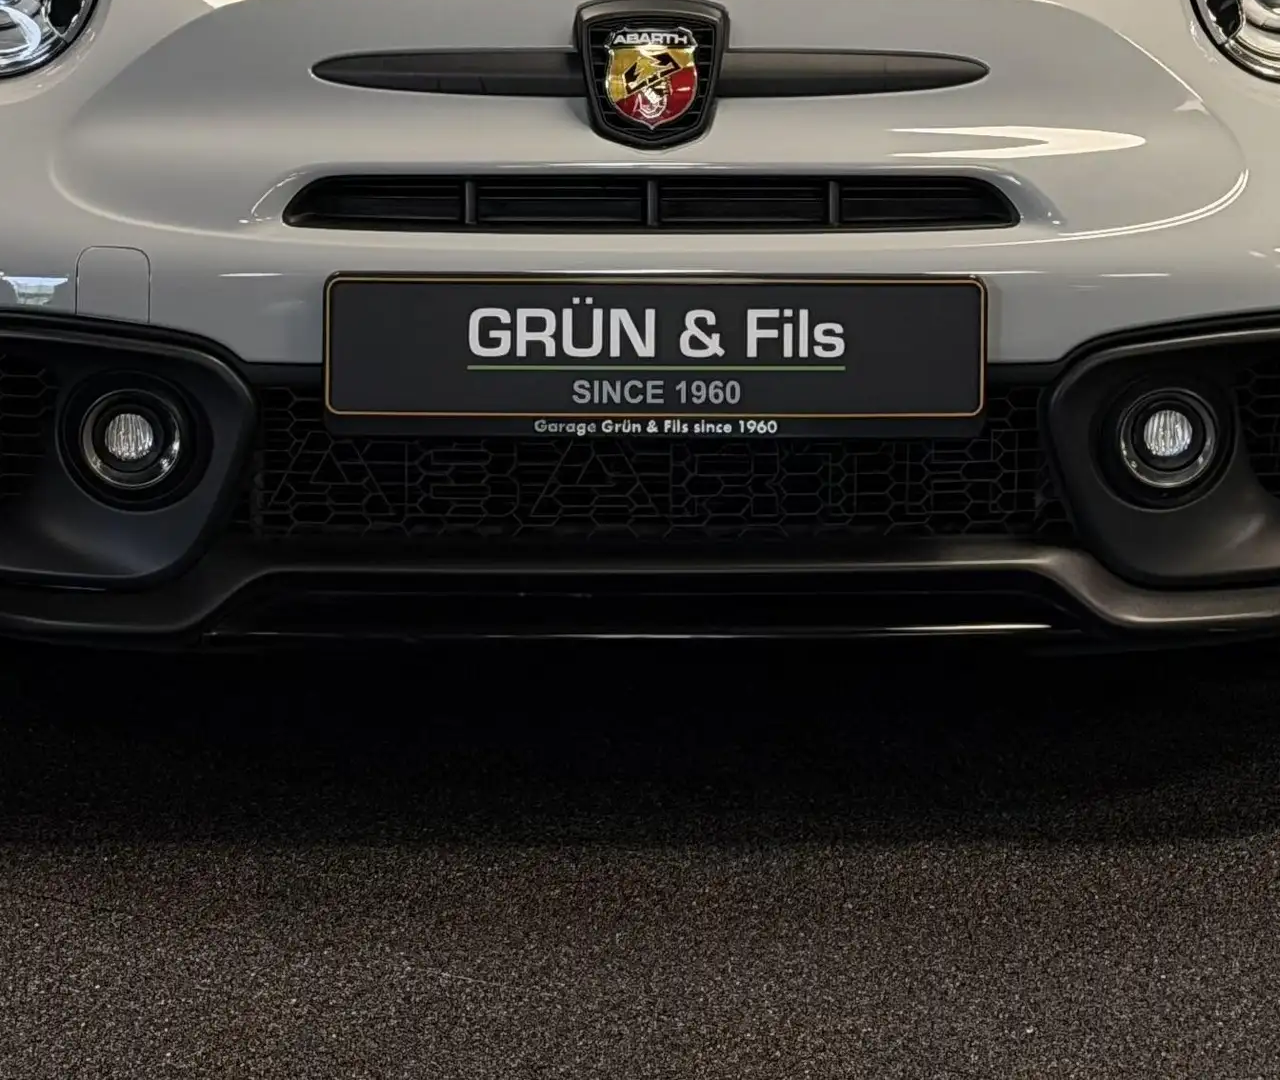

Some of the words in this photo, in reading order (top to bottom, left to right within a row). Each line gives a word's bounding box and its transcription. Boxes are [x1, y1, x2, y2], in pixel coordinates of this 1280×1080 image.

[613, 32, 687, 45] ABARTH
[467, 296, 656, 359] GRÜN
[678, 308, 726, 359] &
[745, 308, 846, 359] Fils
[571, 379, 665, 406] SINCE
[674, 379, 742, 406] 1960
[533, 419, 597, 436] Garage
[601, 418, 642, 434] Grün
[646, 420, 659, 434] &
[663, 419, 689, 434] Fils
[693, 419, 733, 434] since
[738, 419, 779, 434] 1960
